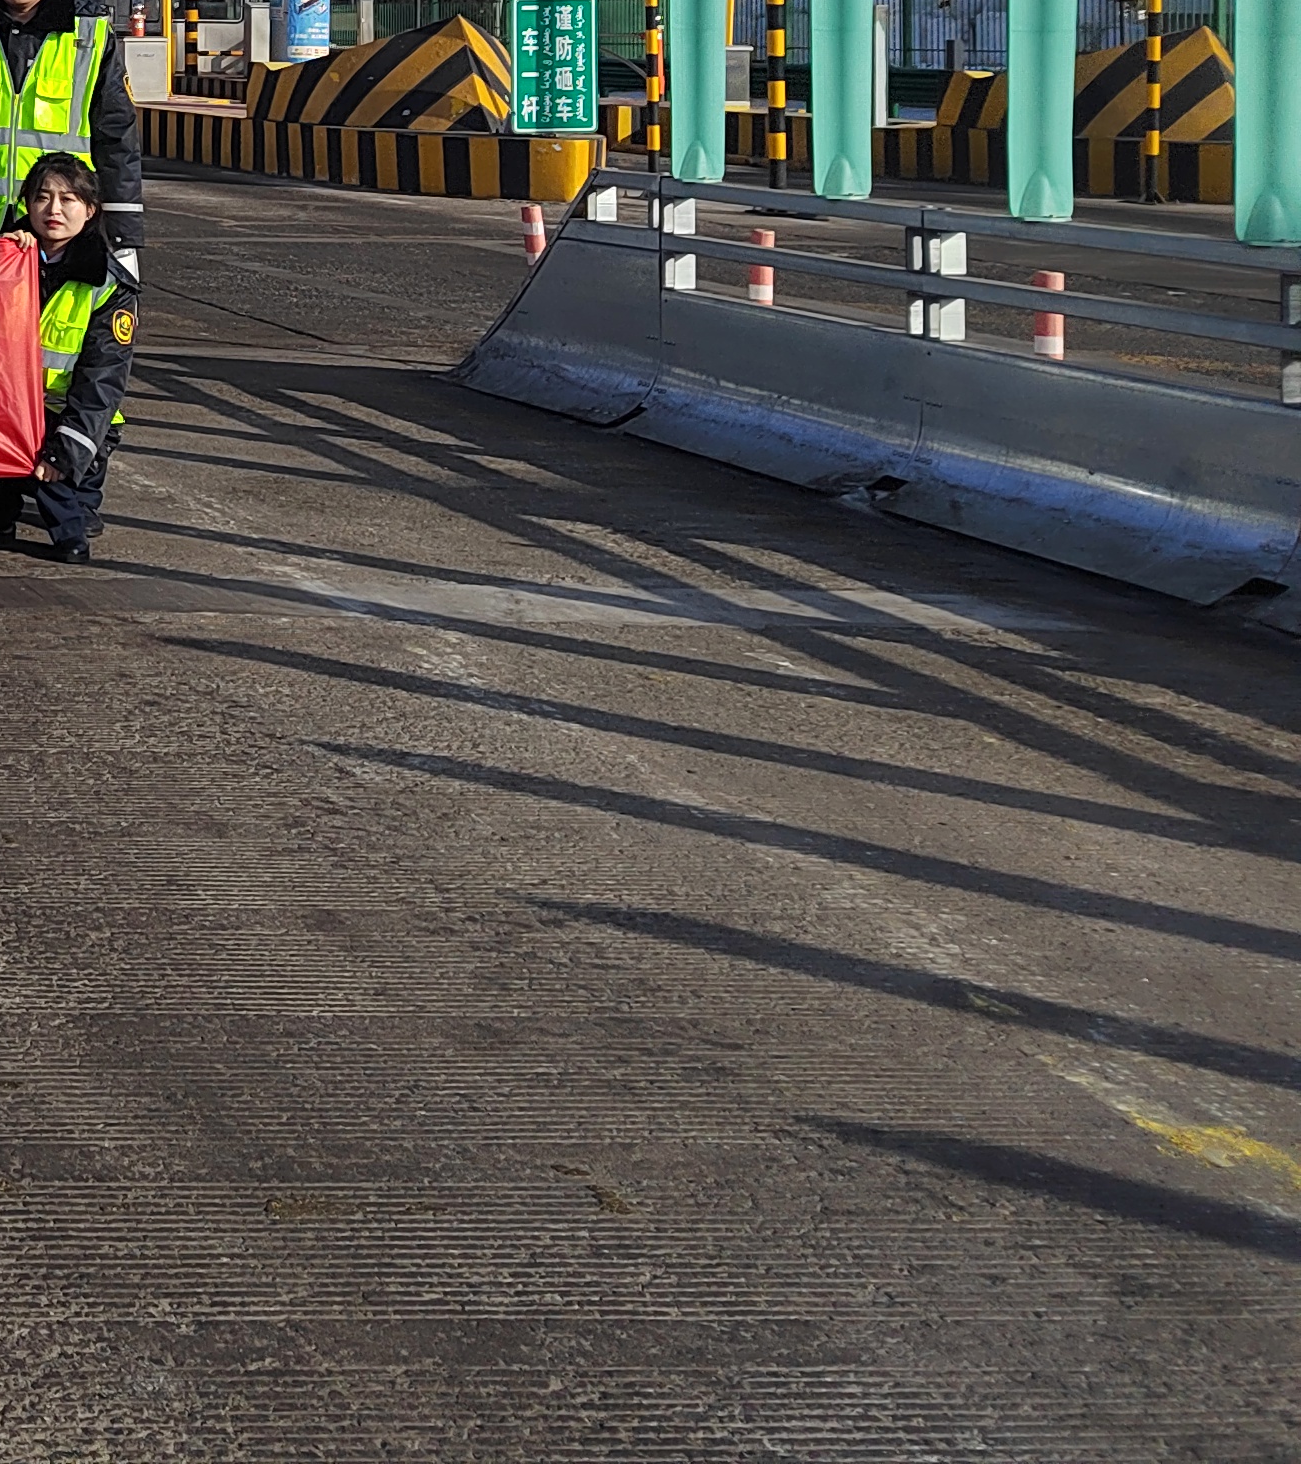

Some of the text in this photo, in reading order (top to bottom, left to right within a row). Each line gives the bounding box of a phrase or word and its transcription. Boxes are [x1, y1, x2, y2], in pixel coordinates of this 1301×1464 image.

[520, 4, 540, 123] 一车一杆
[554, 4, 575, 123] 谨防砸车
